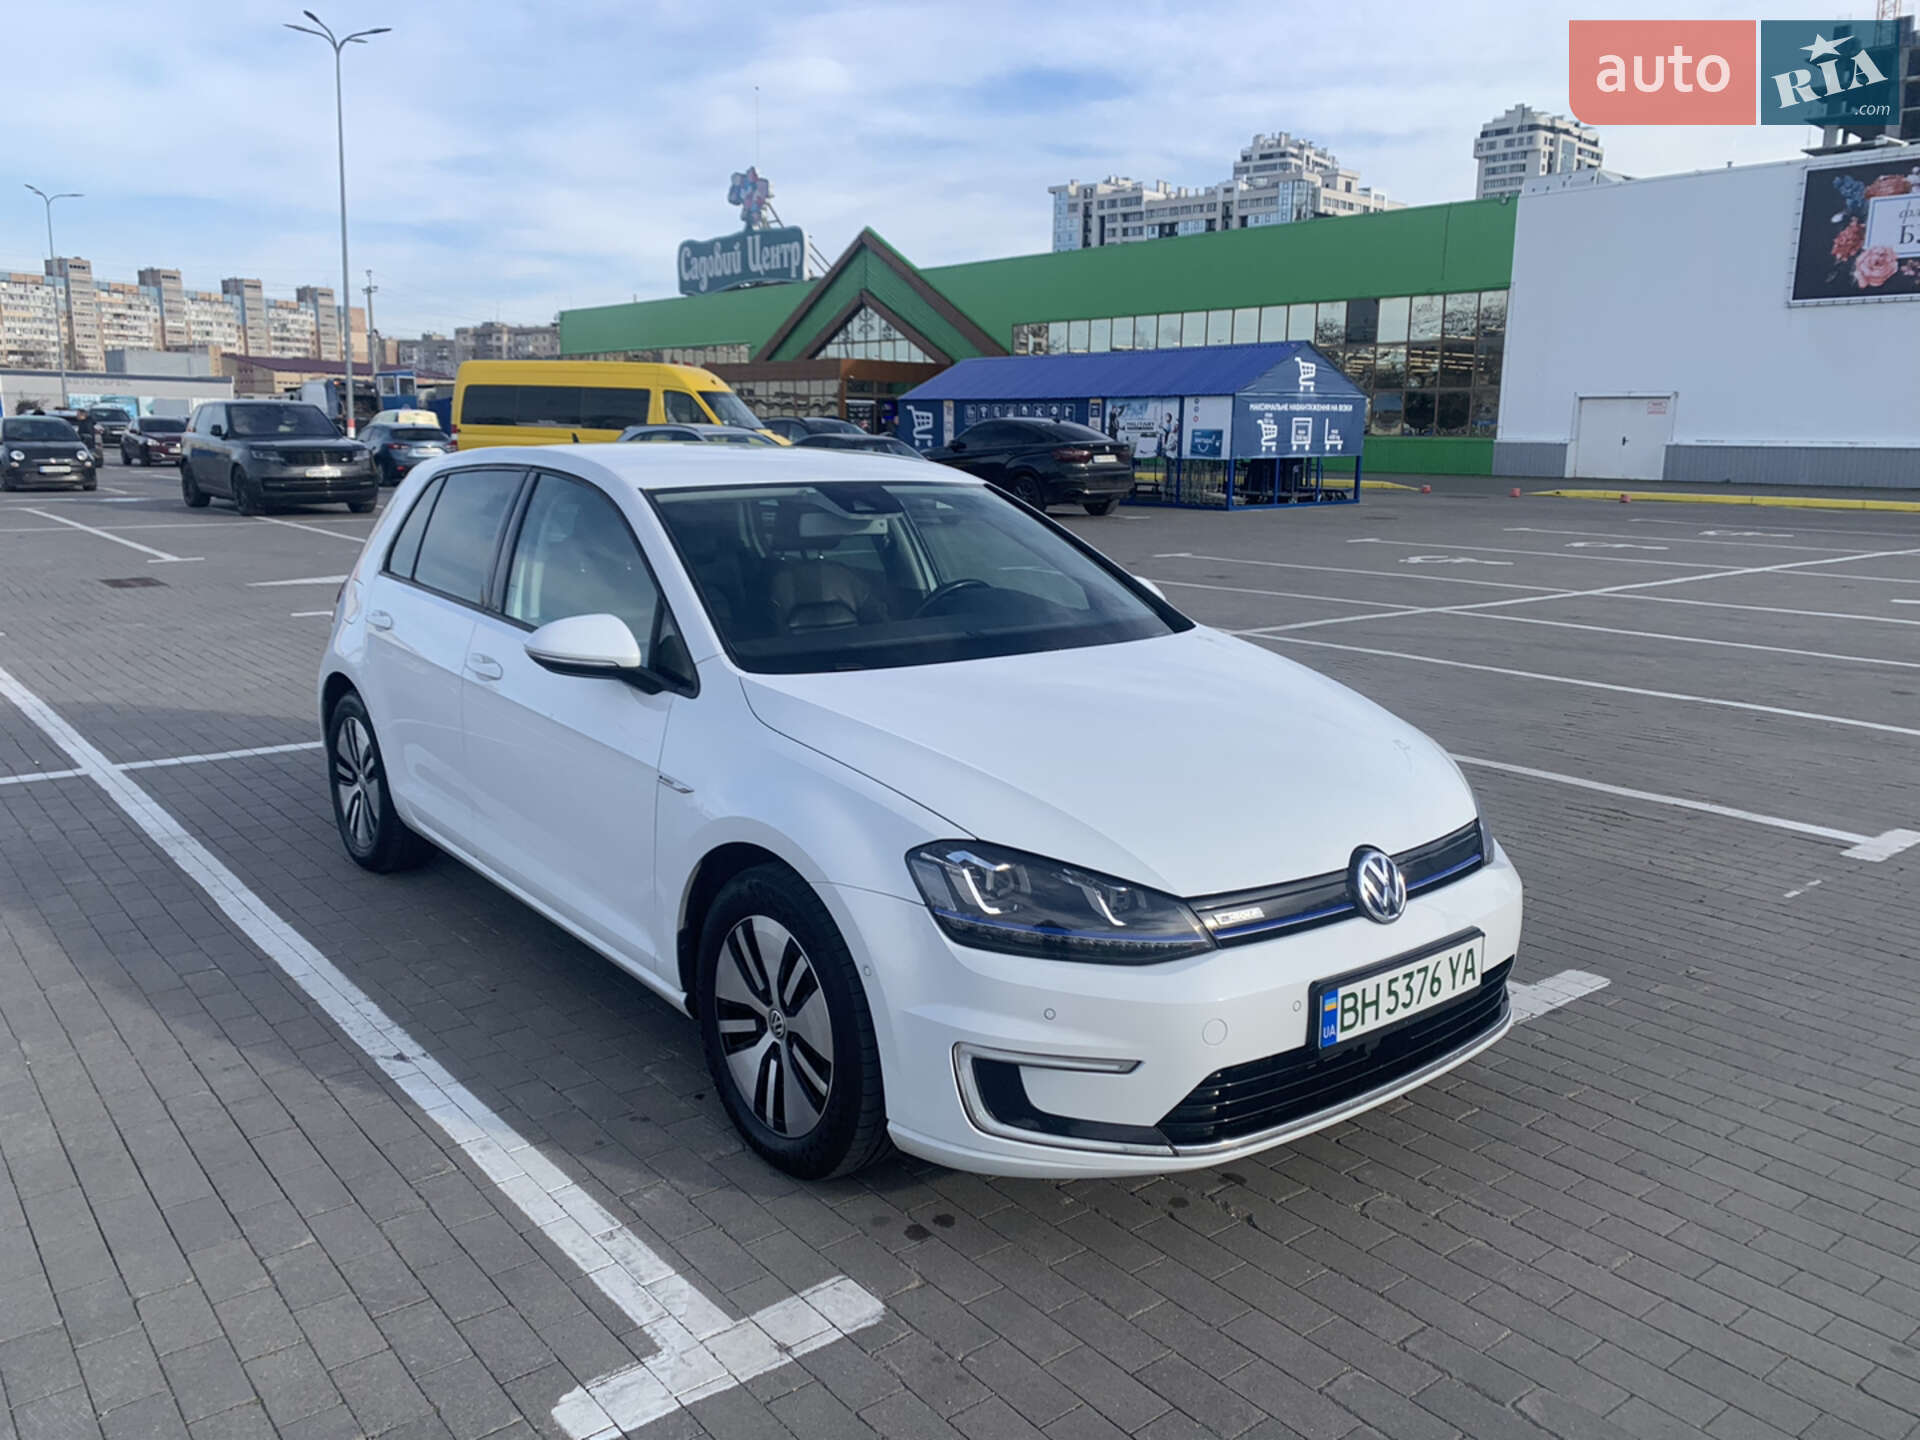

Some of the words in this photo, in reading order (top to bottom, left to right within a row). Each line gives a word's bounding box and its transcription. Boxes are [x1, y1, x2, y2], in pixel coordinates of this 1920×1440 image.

[681, 242, 742, 291] Садовий
[747, 235, 800, 278] Центр
[1340, 983, 1380, 1033] BH
[1385, 961, 1442, 1014] 5376
[1449, 948, 1477, 991] YA
[1323, 1026, 1336, 1039] UA
